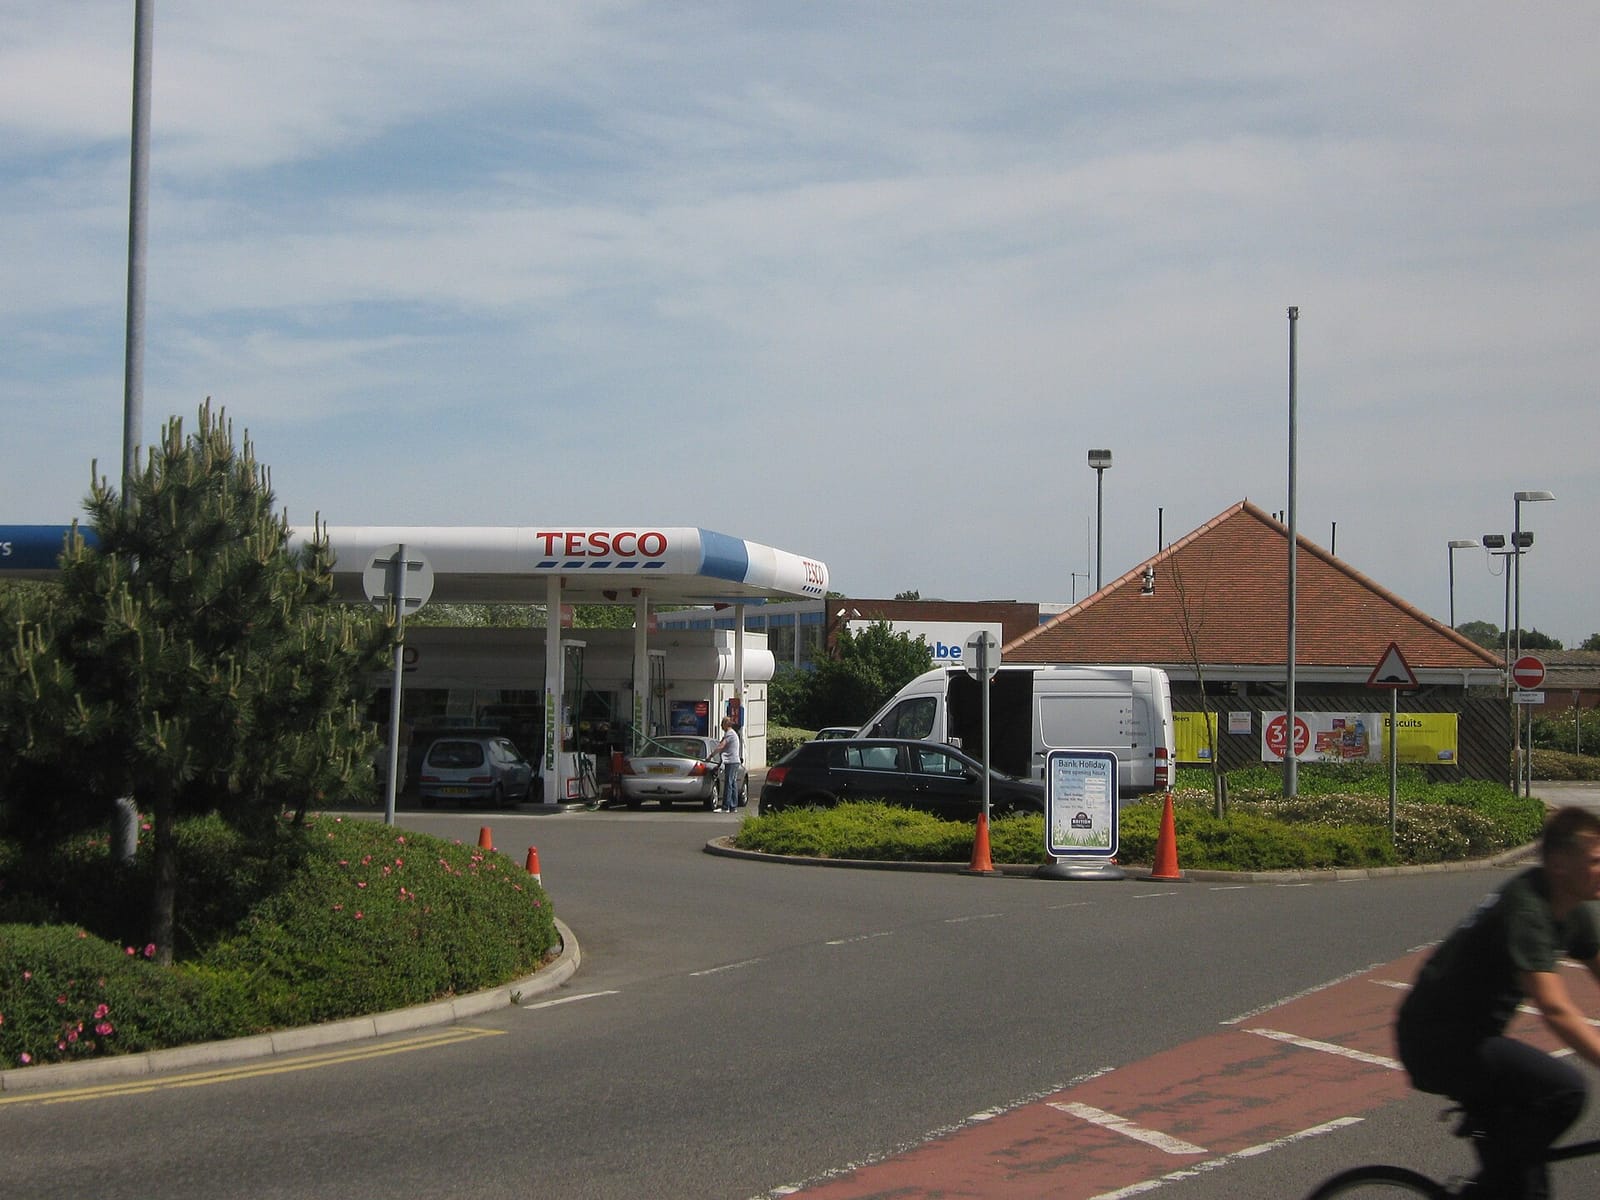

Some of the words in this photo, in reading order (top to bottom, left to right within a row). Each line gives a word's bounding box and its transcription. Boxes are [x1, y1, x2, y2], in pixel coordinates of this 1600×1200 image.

[536, 532, 668, 557] TESCO
[802, 560, 824, 585] TESCO
[1384, 718, 1423, 728] Bscuits
[1058, 759, 1077, 768] Bank
[1079, 760, 1106, 770] Holiday
